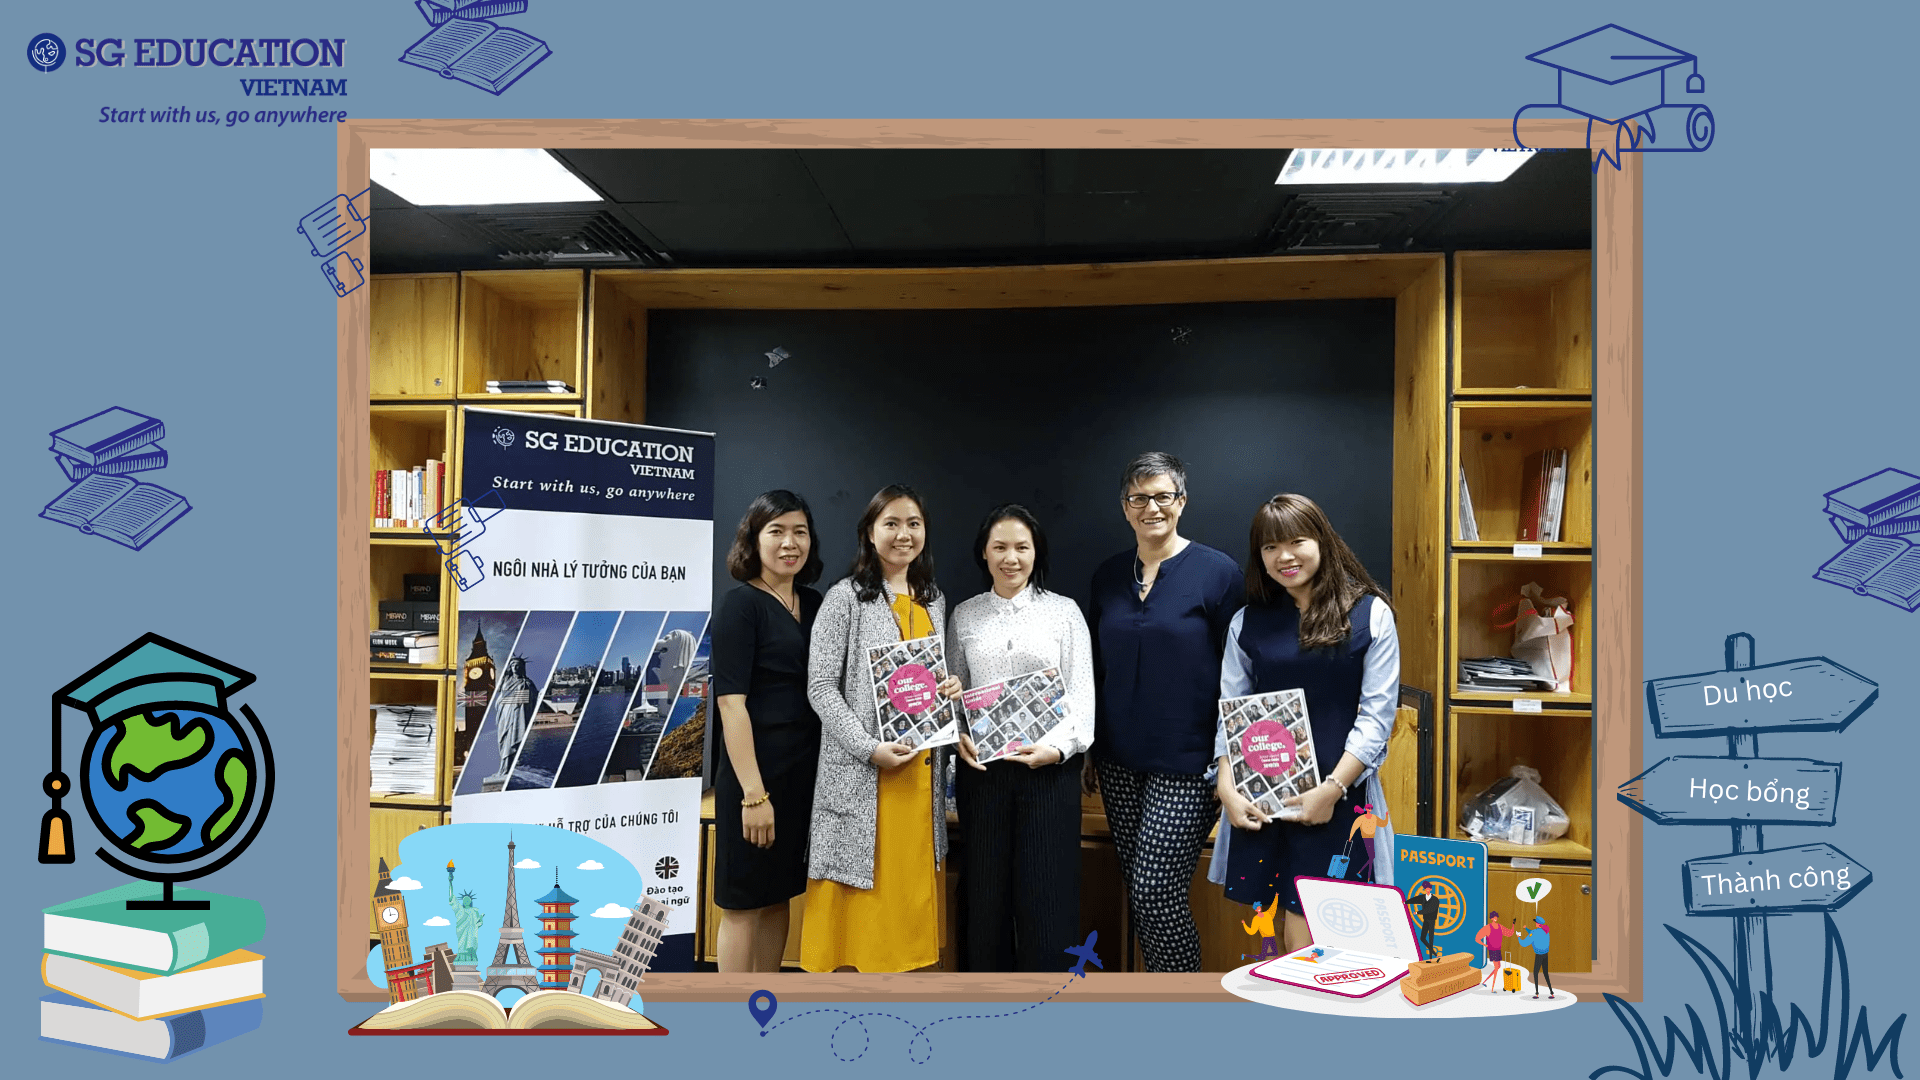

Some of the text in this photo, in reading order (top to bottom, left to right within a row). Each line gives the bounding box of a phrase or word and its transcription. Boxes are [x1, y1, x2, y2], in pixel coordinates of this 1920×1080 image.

[525, 430, 694, 464] SG EDUCATION
[630, 464, 695, 480] VIETNAM
[492, 475, 696, 501] Start with us, go anywhere
[493, 558, 686, 583] NGÔI NHÀ LÝ TƯỞNG CỦA BẠN
[1251, 734, 1269, 743] our
[1248, 742, 1286, 752] college.
[568, 819, 591, 834] TRỢ
[595, 813, 616, 830] CỦA
[620, 811, 658, 827] CHÚNG
[662, 809, 679, 824] TÔI
[646, 885, 684, 895] Đào tạo
[671, 895, 690, 906] ngữ
